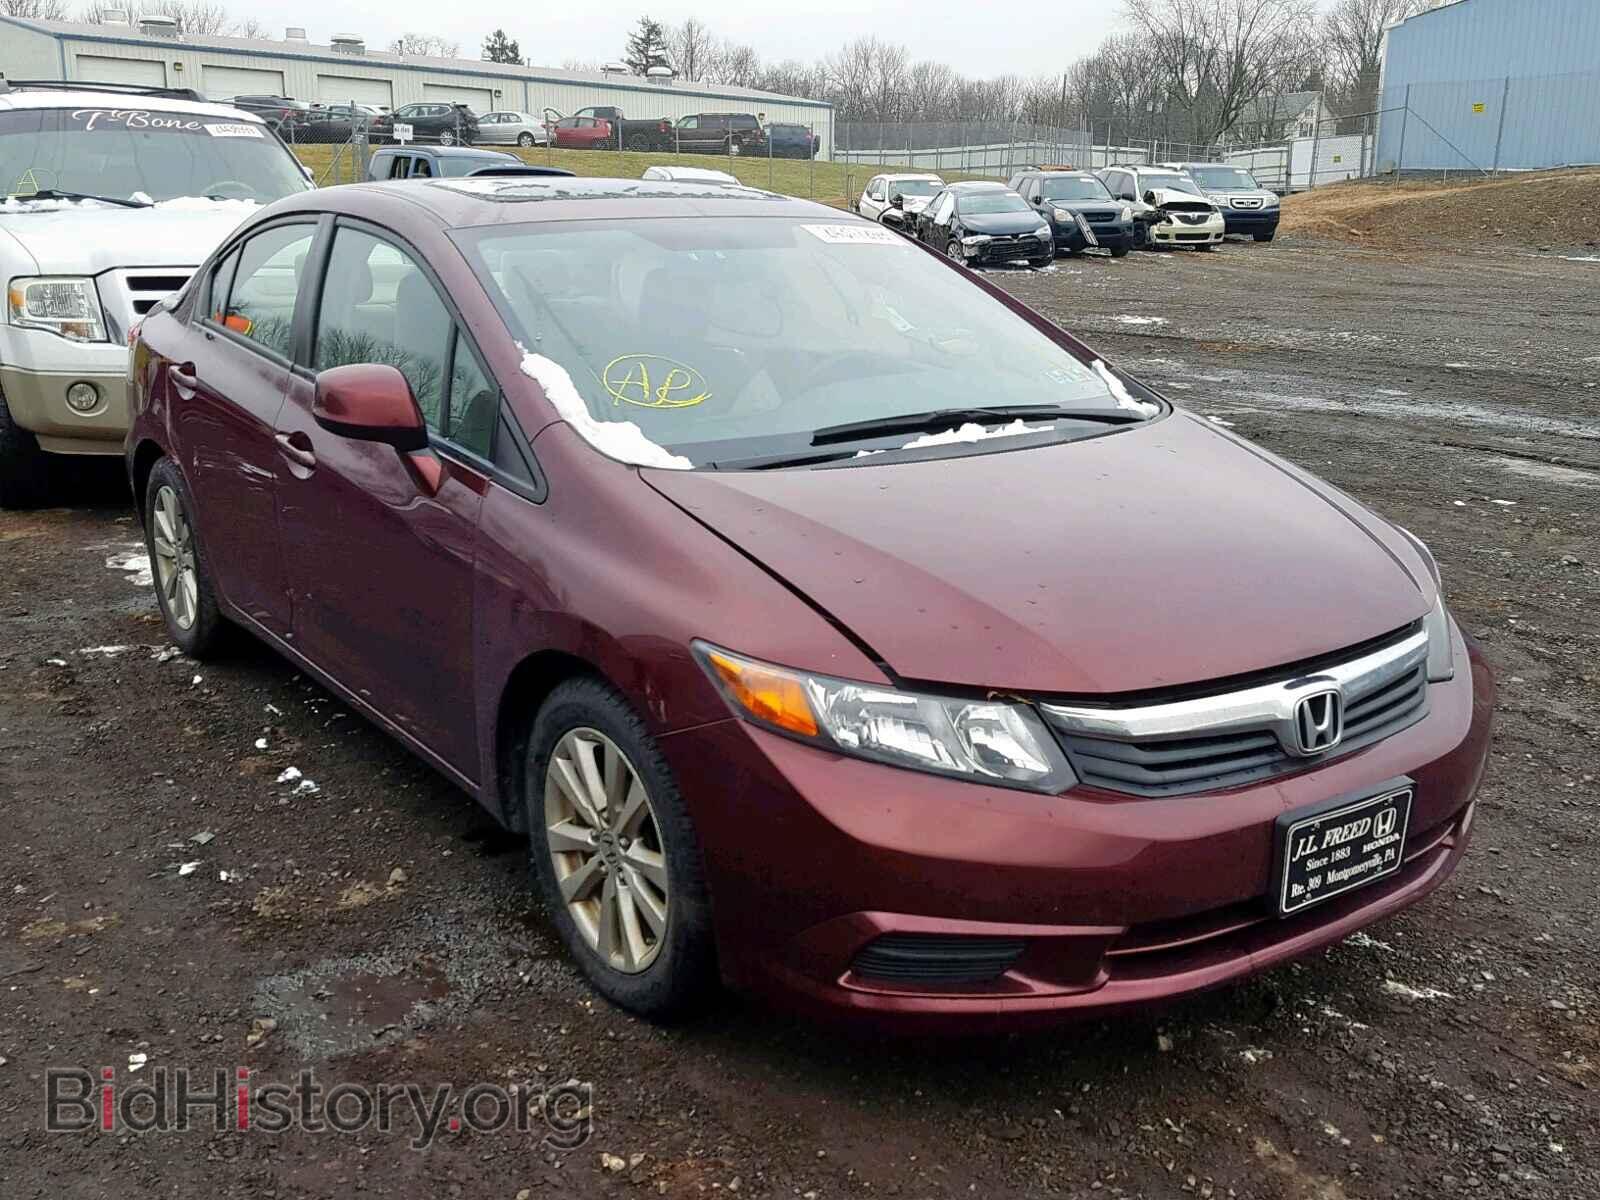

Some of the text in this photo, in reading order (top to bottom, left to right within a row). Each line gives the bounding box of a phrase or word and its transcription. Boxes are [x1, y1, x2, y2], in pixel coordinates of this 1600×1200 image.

[1320, 817, 1371, 849] FREED
[1362, 832, 1400, 853] HONDA
[1305, 846, 1351, 871] Since 1883
[1384, 847, 1396, 862] PA
